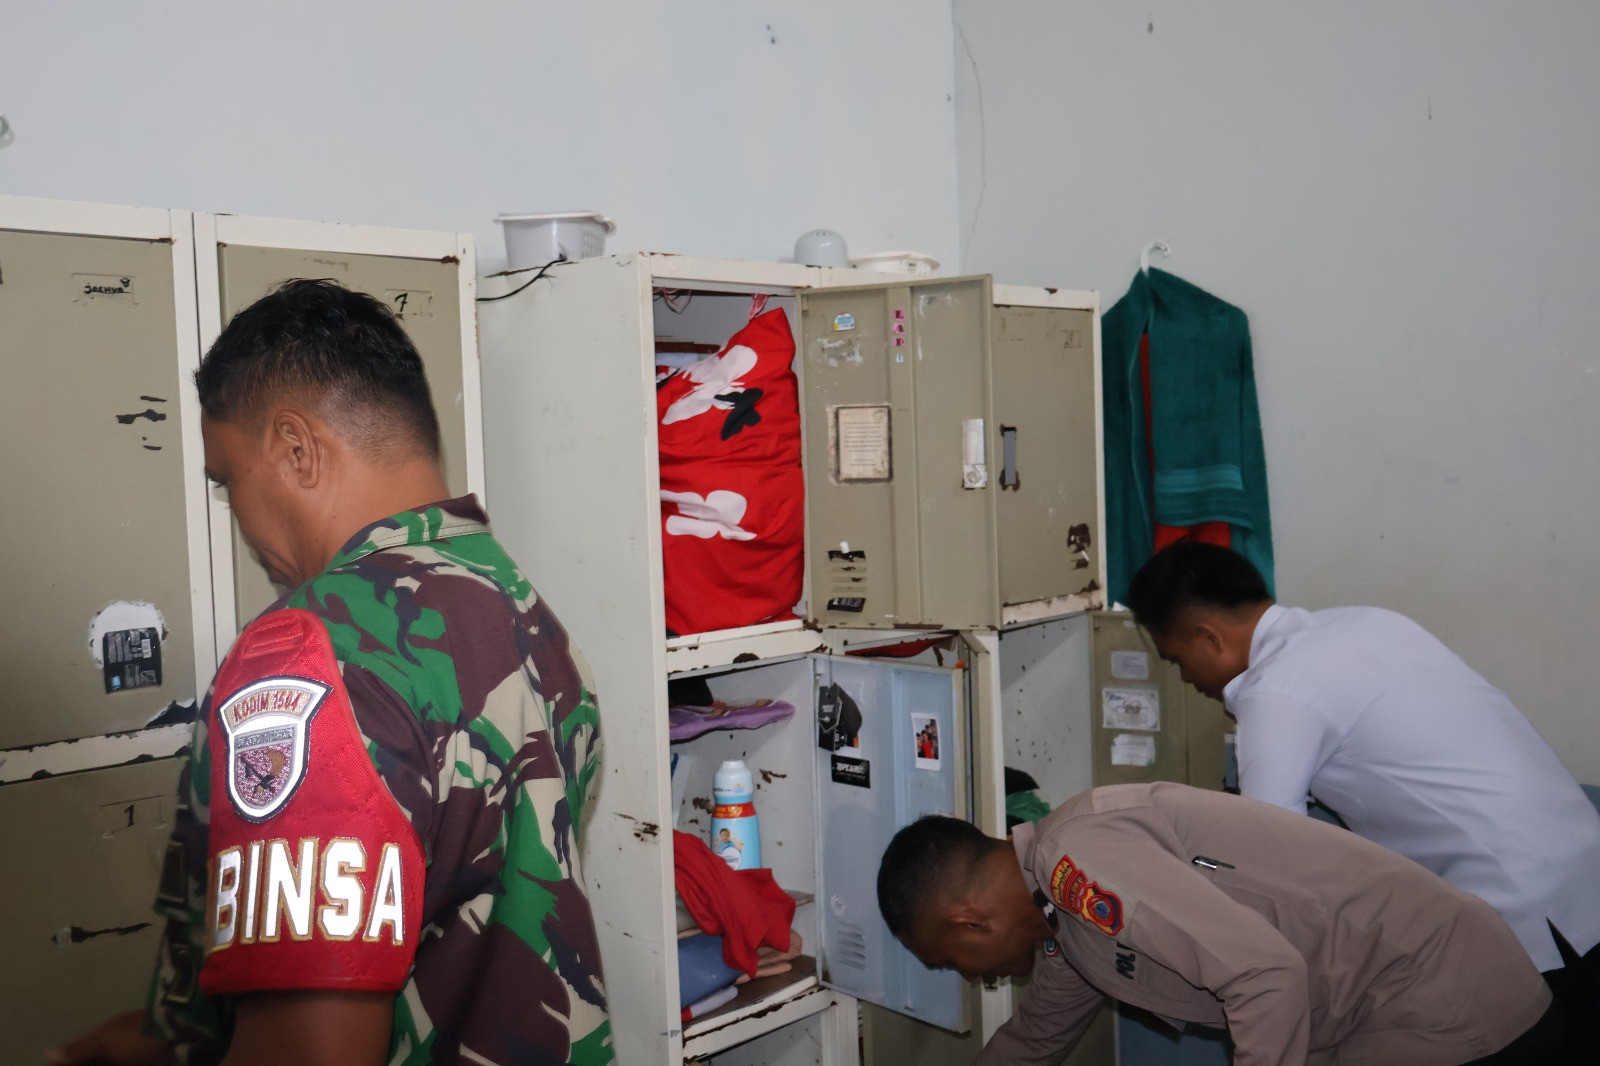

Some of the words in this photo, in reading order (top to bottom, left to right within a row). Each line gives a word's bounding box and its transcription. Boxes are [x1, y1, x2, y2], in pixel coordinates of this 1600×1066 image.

[394, 292, 408, 312] 7
[232, 692, 271, 722] KODIM
[273, 689, 303, 711] 1504
[124, 804, 135, 828] 1
